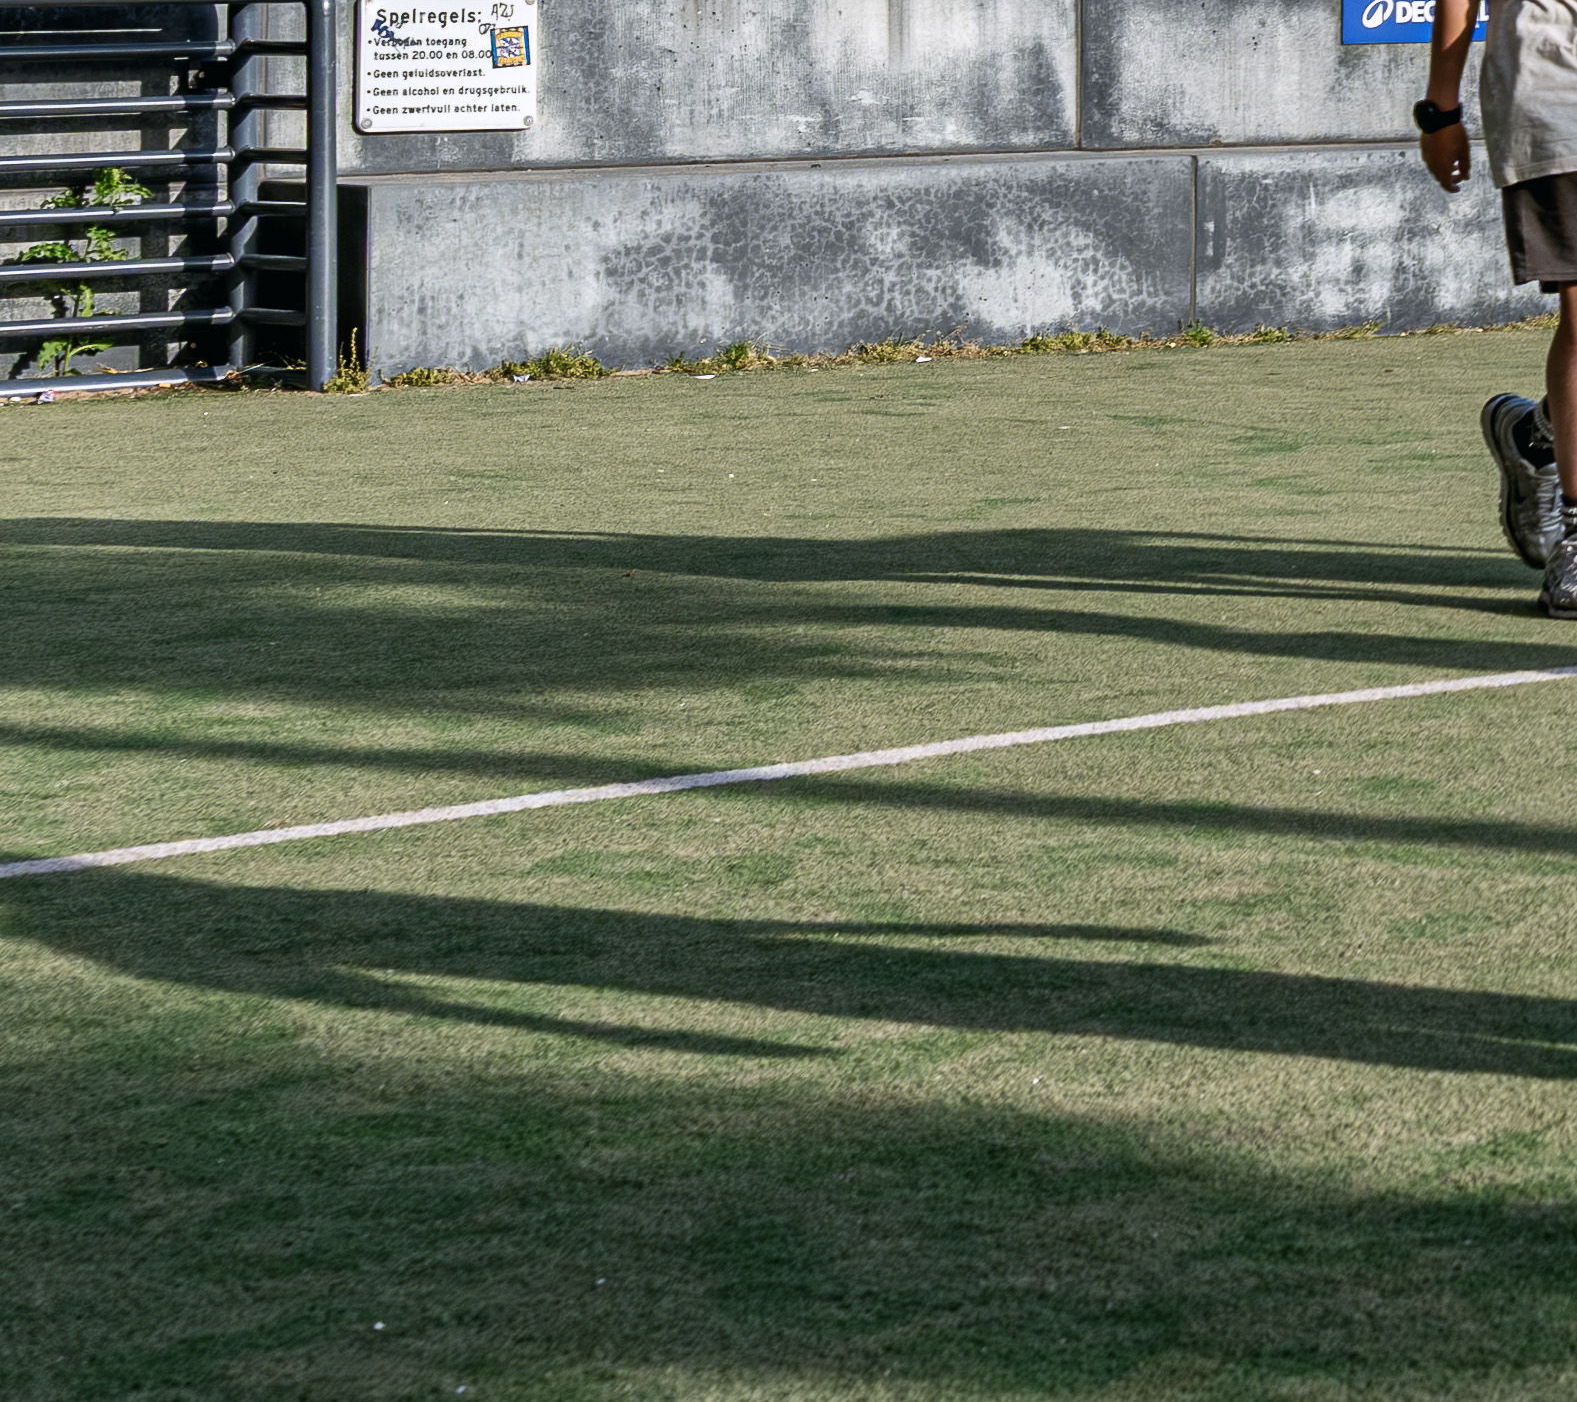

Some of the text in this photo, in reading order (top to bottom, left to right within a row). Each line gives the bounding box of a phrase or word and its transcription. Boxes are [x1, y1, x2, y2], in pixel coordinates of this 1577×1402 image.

[377, 8, 482, 27] Spelregels:
[426, 37, 467, 48] toegang
[374, 49, 492, 61] tussen 20.00 en 08.00
[373, 69, 399, 79] Geen
[373, 85, 531, 97] Geen alcohol en drugsgebruik.
[372, 103, 521, 115] Geen zwerfvuil achter laten.
